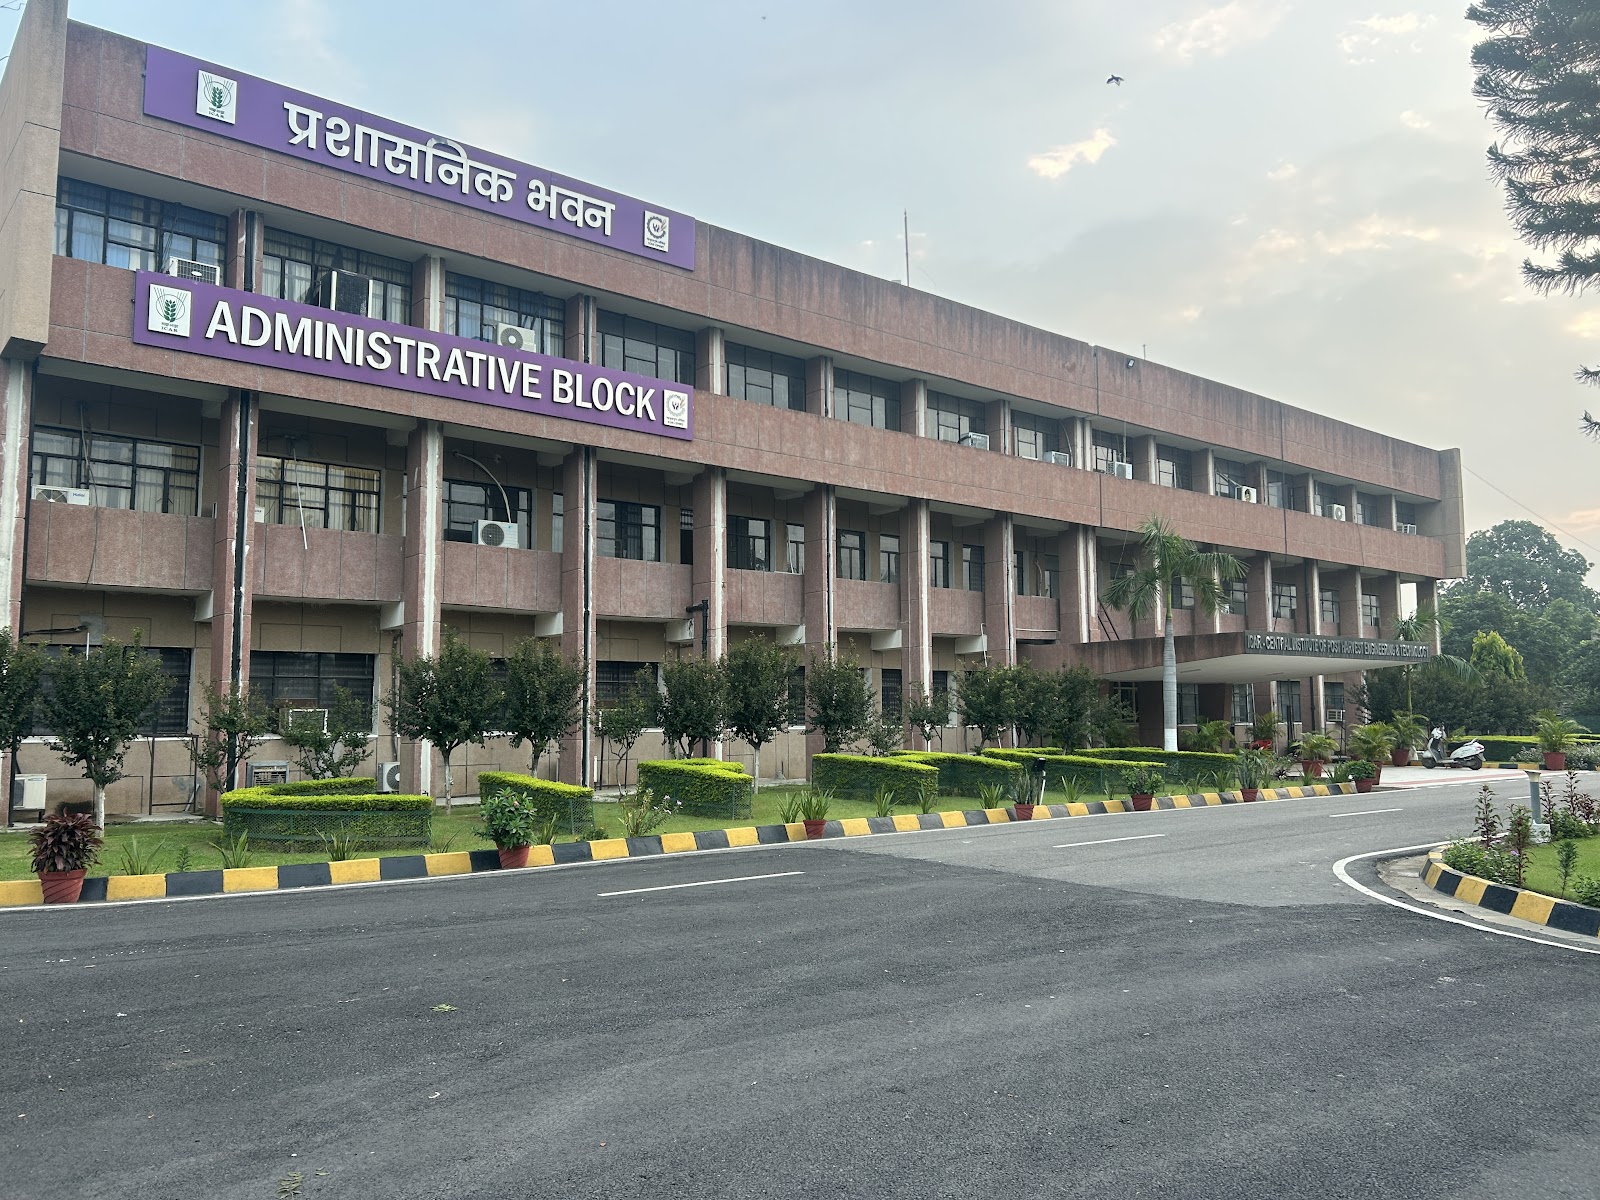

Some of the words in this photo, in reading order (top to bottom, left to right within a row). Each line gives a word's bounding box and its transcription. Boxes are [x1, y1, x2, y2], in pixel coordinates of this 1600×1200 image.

[283, 101, 517, 203] प्रशासनिक
[527, 178, 616, 236] भवन
[205, 300, 542, 399] ADMINISTRATIVE
[552, 369, 656, 421] BLOCK
[1247, 634, 1262, 649] ICAR
[1265, 635, 1292, 651] CENTRAL
[1292, 637, 1318, 653] INSTITUTE
[1319, 639, 1327, 653] OF
[1327, 640, 1340, 653] POST
[1341, 641, 1364, 654] HARVEST
[1364, 642, 1396, 656] ENGINEERING
[1400, 644, 1429, 658] TECHNOLOGY
